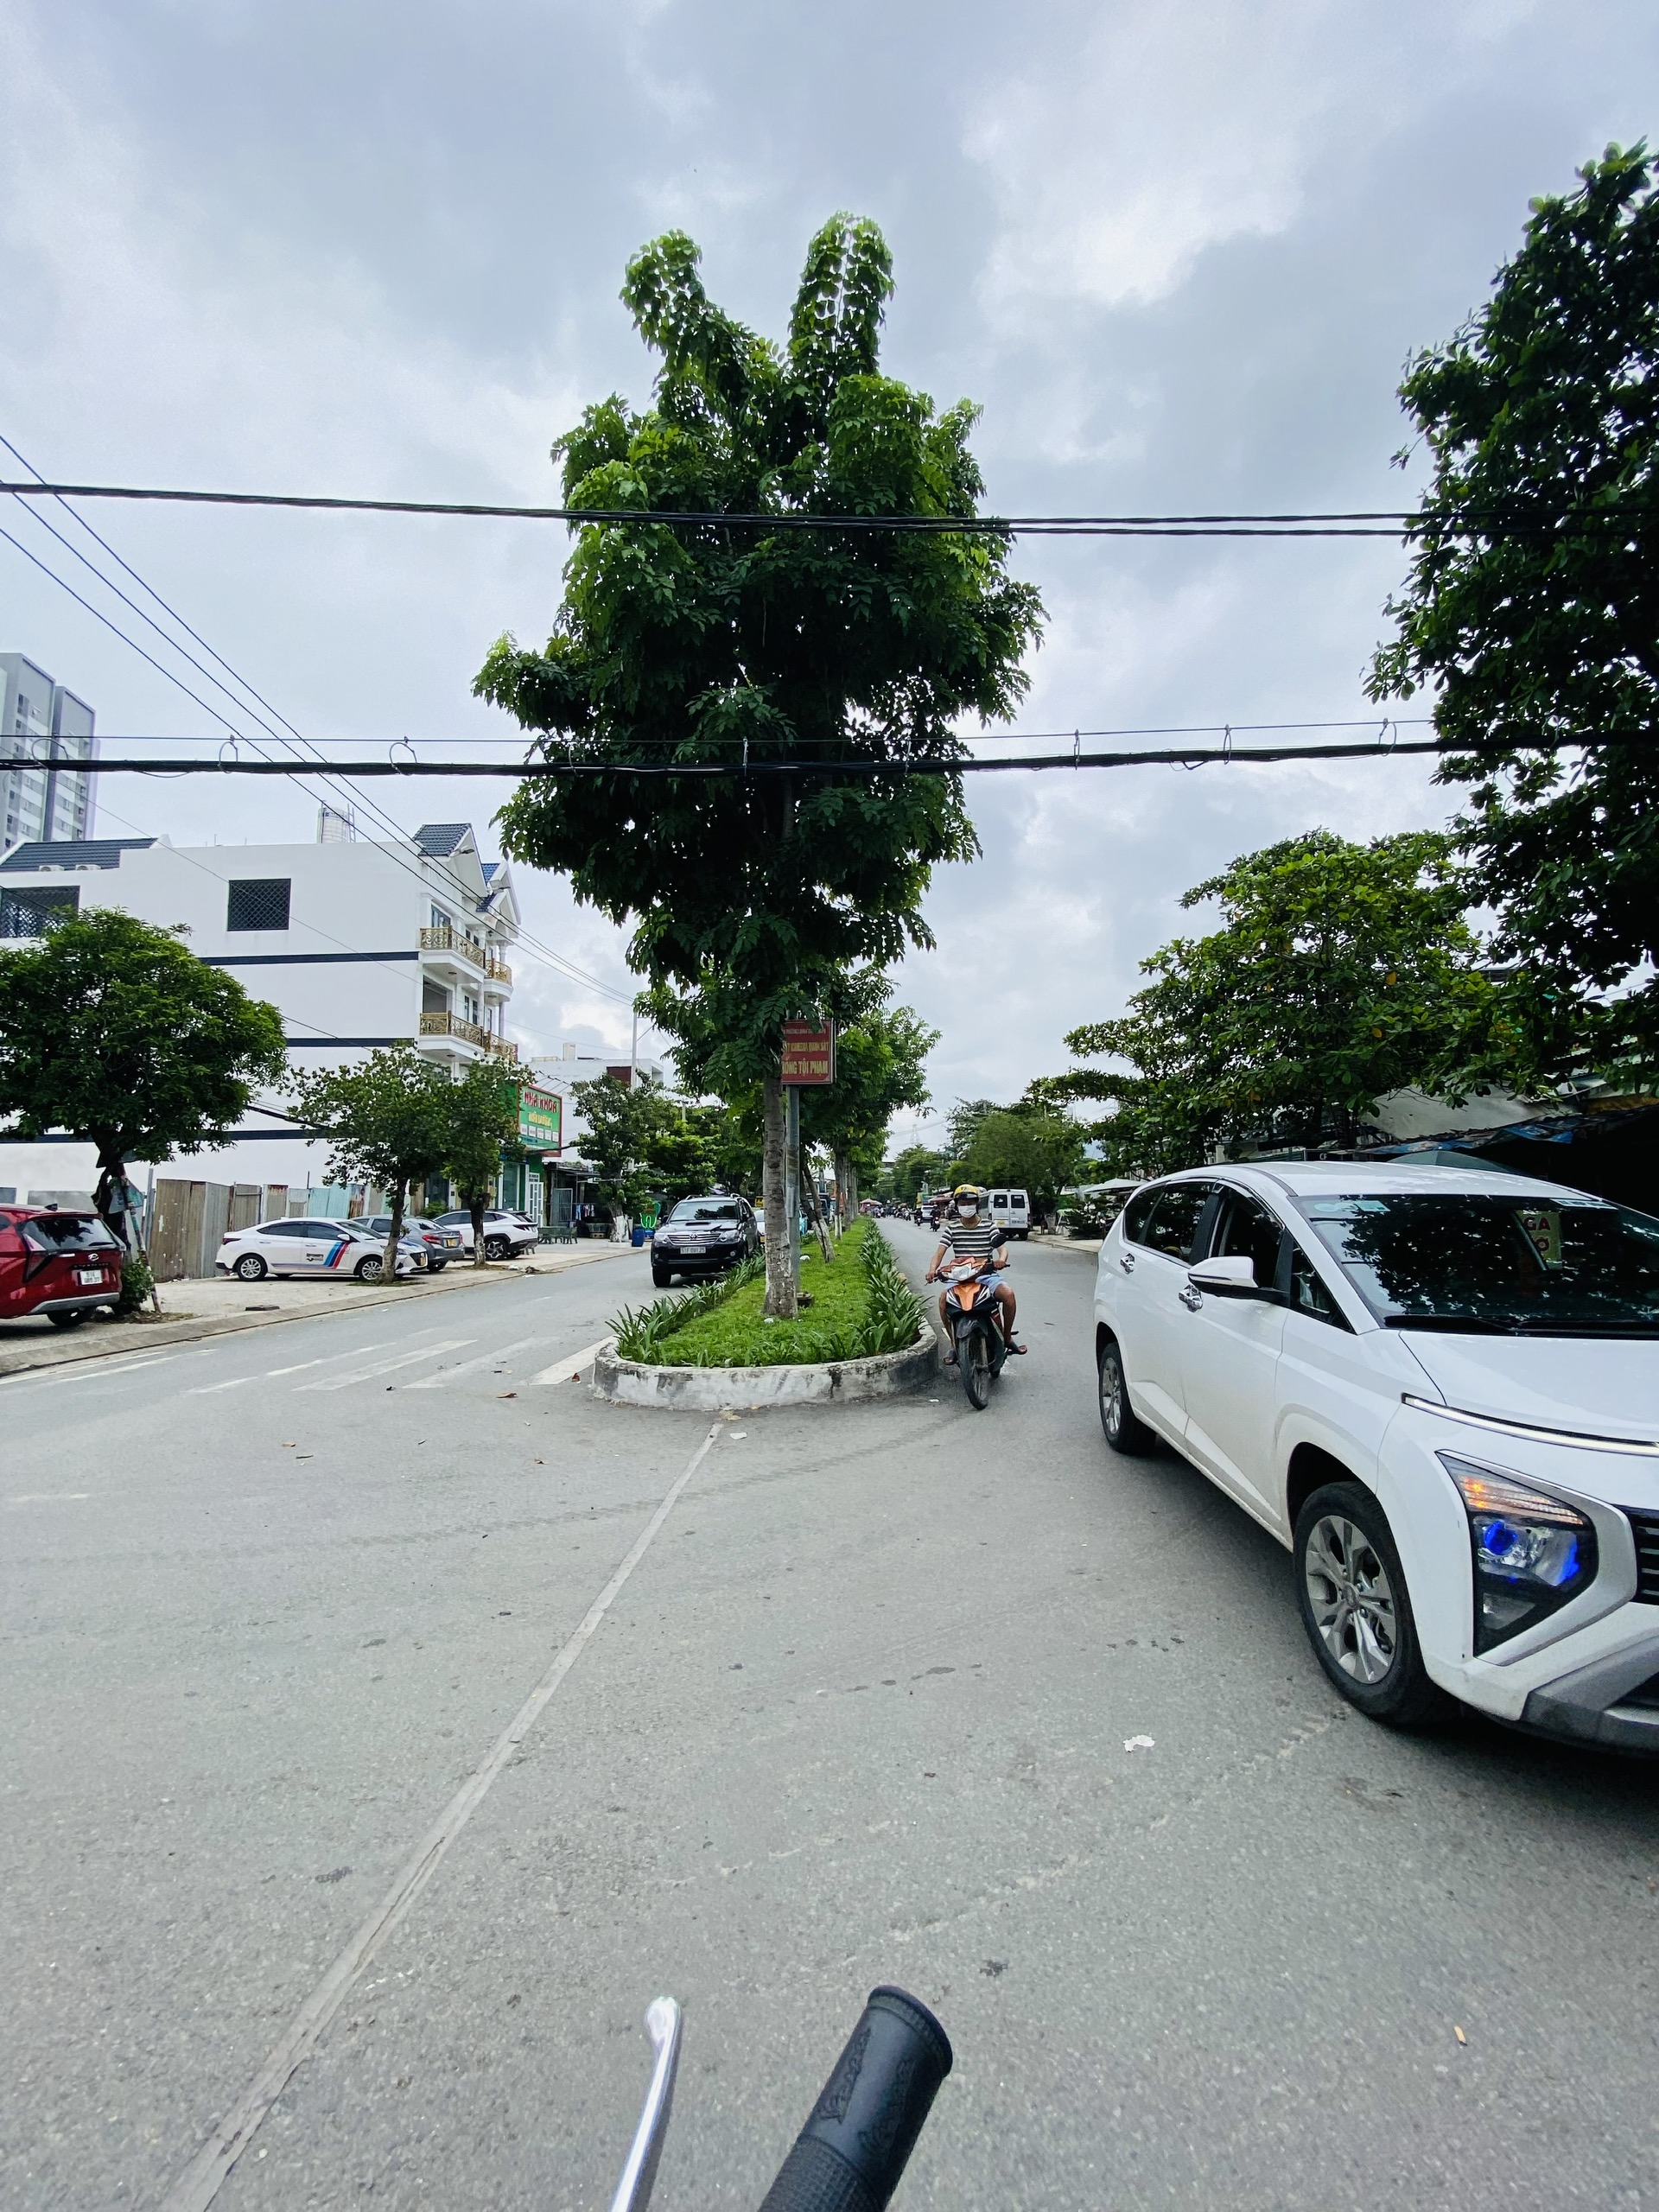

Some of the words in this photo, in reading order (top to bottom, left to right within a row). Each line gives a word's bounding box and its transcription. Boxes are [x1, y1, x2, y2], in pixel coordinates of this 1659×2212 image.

[798, 1058, 809, 1077] TỘI
[810, 1060, 829, 1077] PHẠM
[524, 1090, 538, 1107] NHA
[538, 1096, 557, 1113] KHOA
